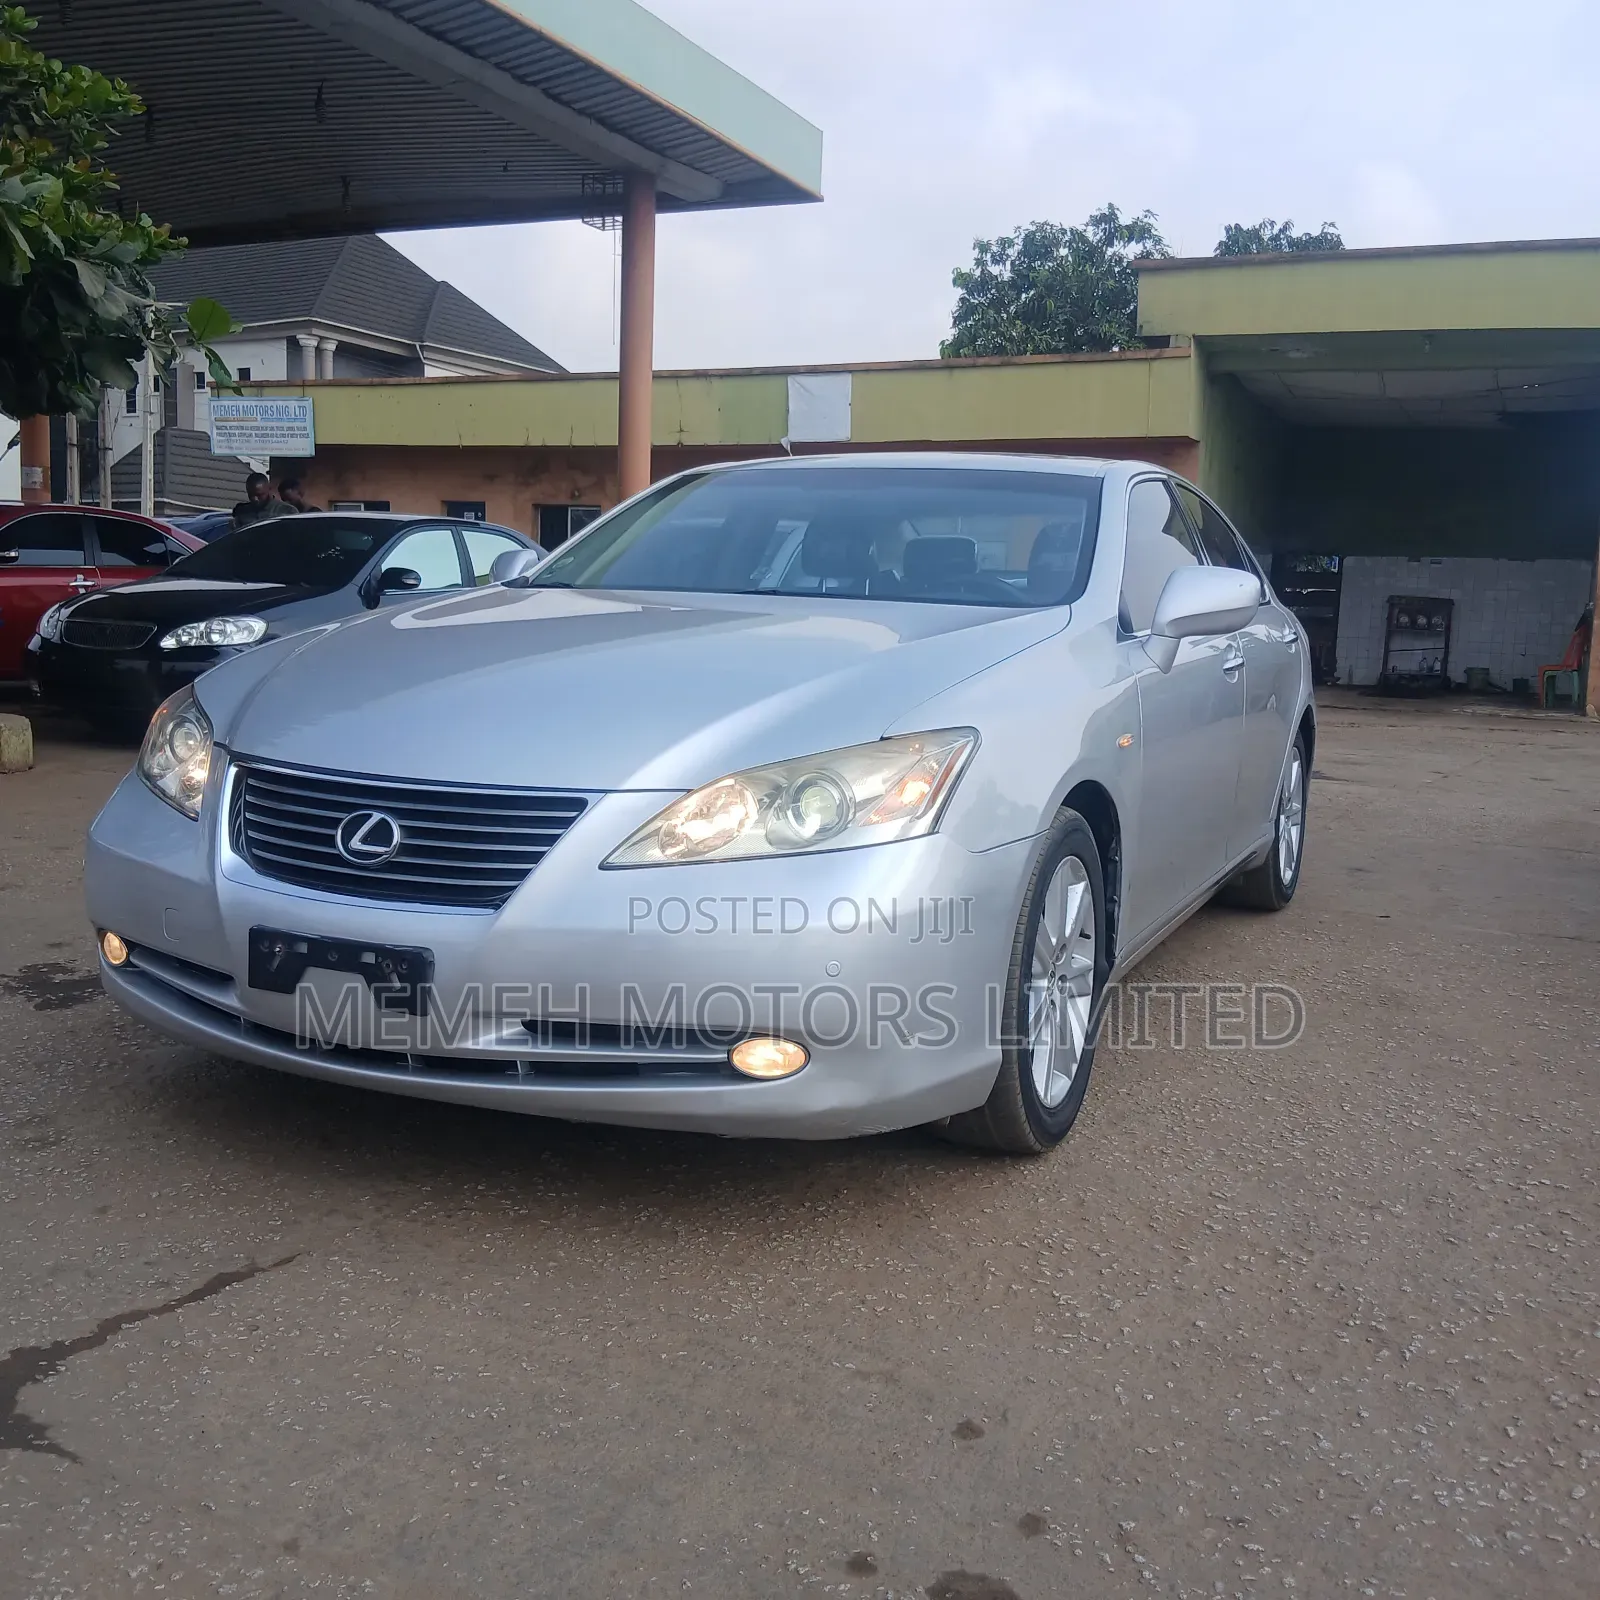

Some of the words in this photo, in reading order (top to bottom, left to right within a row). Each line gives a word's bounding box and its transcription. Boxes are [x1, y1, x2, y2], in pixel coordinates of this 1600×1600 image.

[213, 405, 241, 417] MEMEH
[242, 405, 274, 417] MOTORS
[294, 405, 308, 418] LTD
